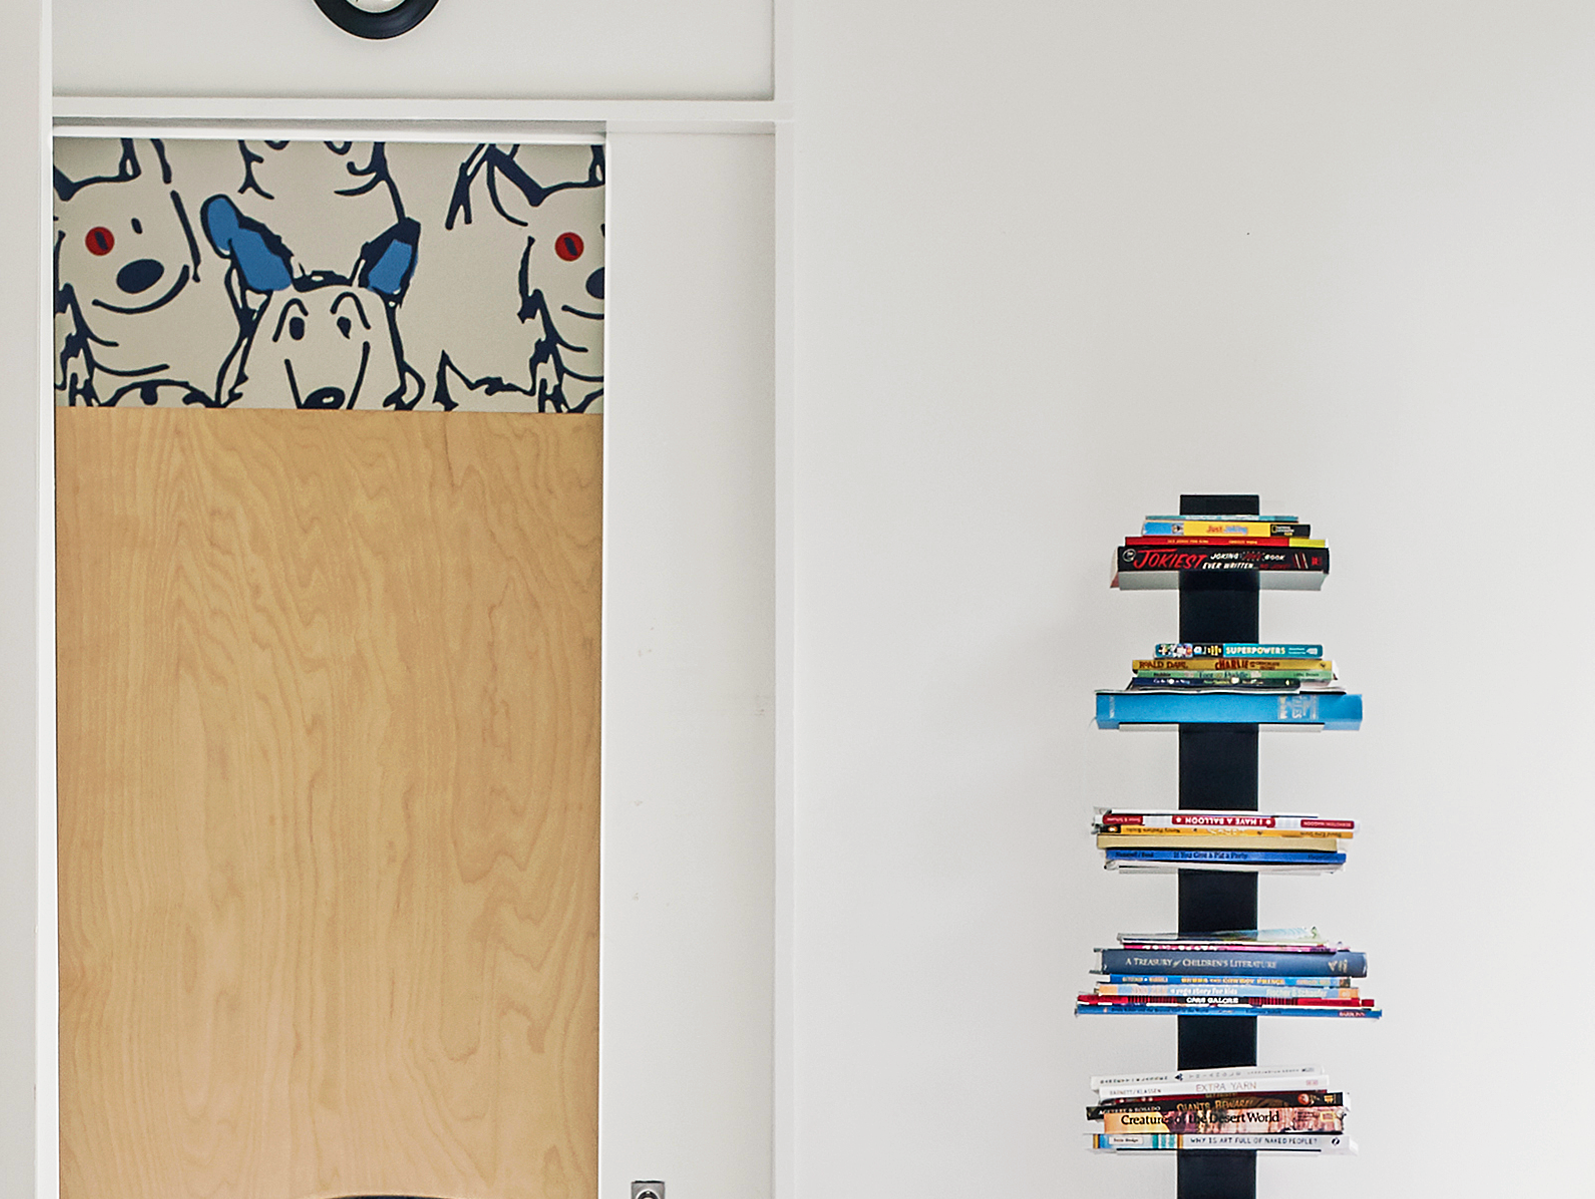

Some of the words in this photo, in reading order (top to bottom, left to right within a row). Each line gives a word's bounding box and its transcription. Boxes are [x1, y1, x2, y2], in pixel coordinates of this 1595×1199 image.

[1134, 549, 1207, 569] JOKIEST
[1210, 552, 1238, 560] JOKING
[1202, 562, 1222, 570] EVER
[1226, 646, 1286, 654] SUPERPOWERS
[1185, 816, 1224, 824] BALLOON
[1236, 818, 1256, 826] HAVE
[1134, 958, 1172, 966] TREASURY
[1183, 959, 1228, 968] CHILDREN'S
[1230, 959, 1277, 968] LITERATURE
[1196, 1084, 1225, 1092] EXTRA
[1231, 1082, 1257, 1090] YARN
[1208, 1112, 1246, 1123] Desert
[1247, 1111, 1280, 1122] World
